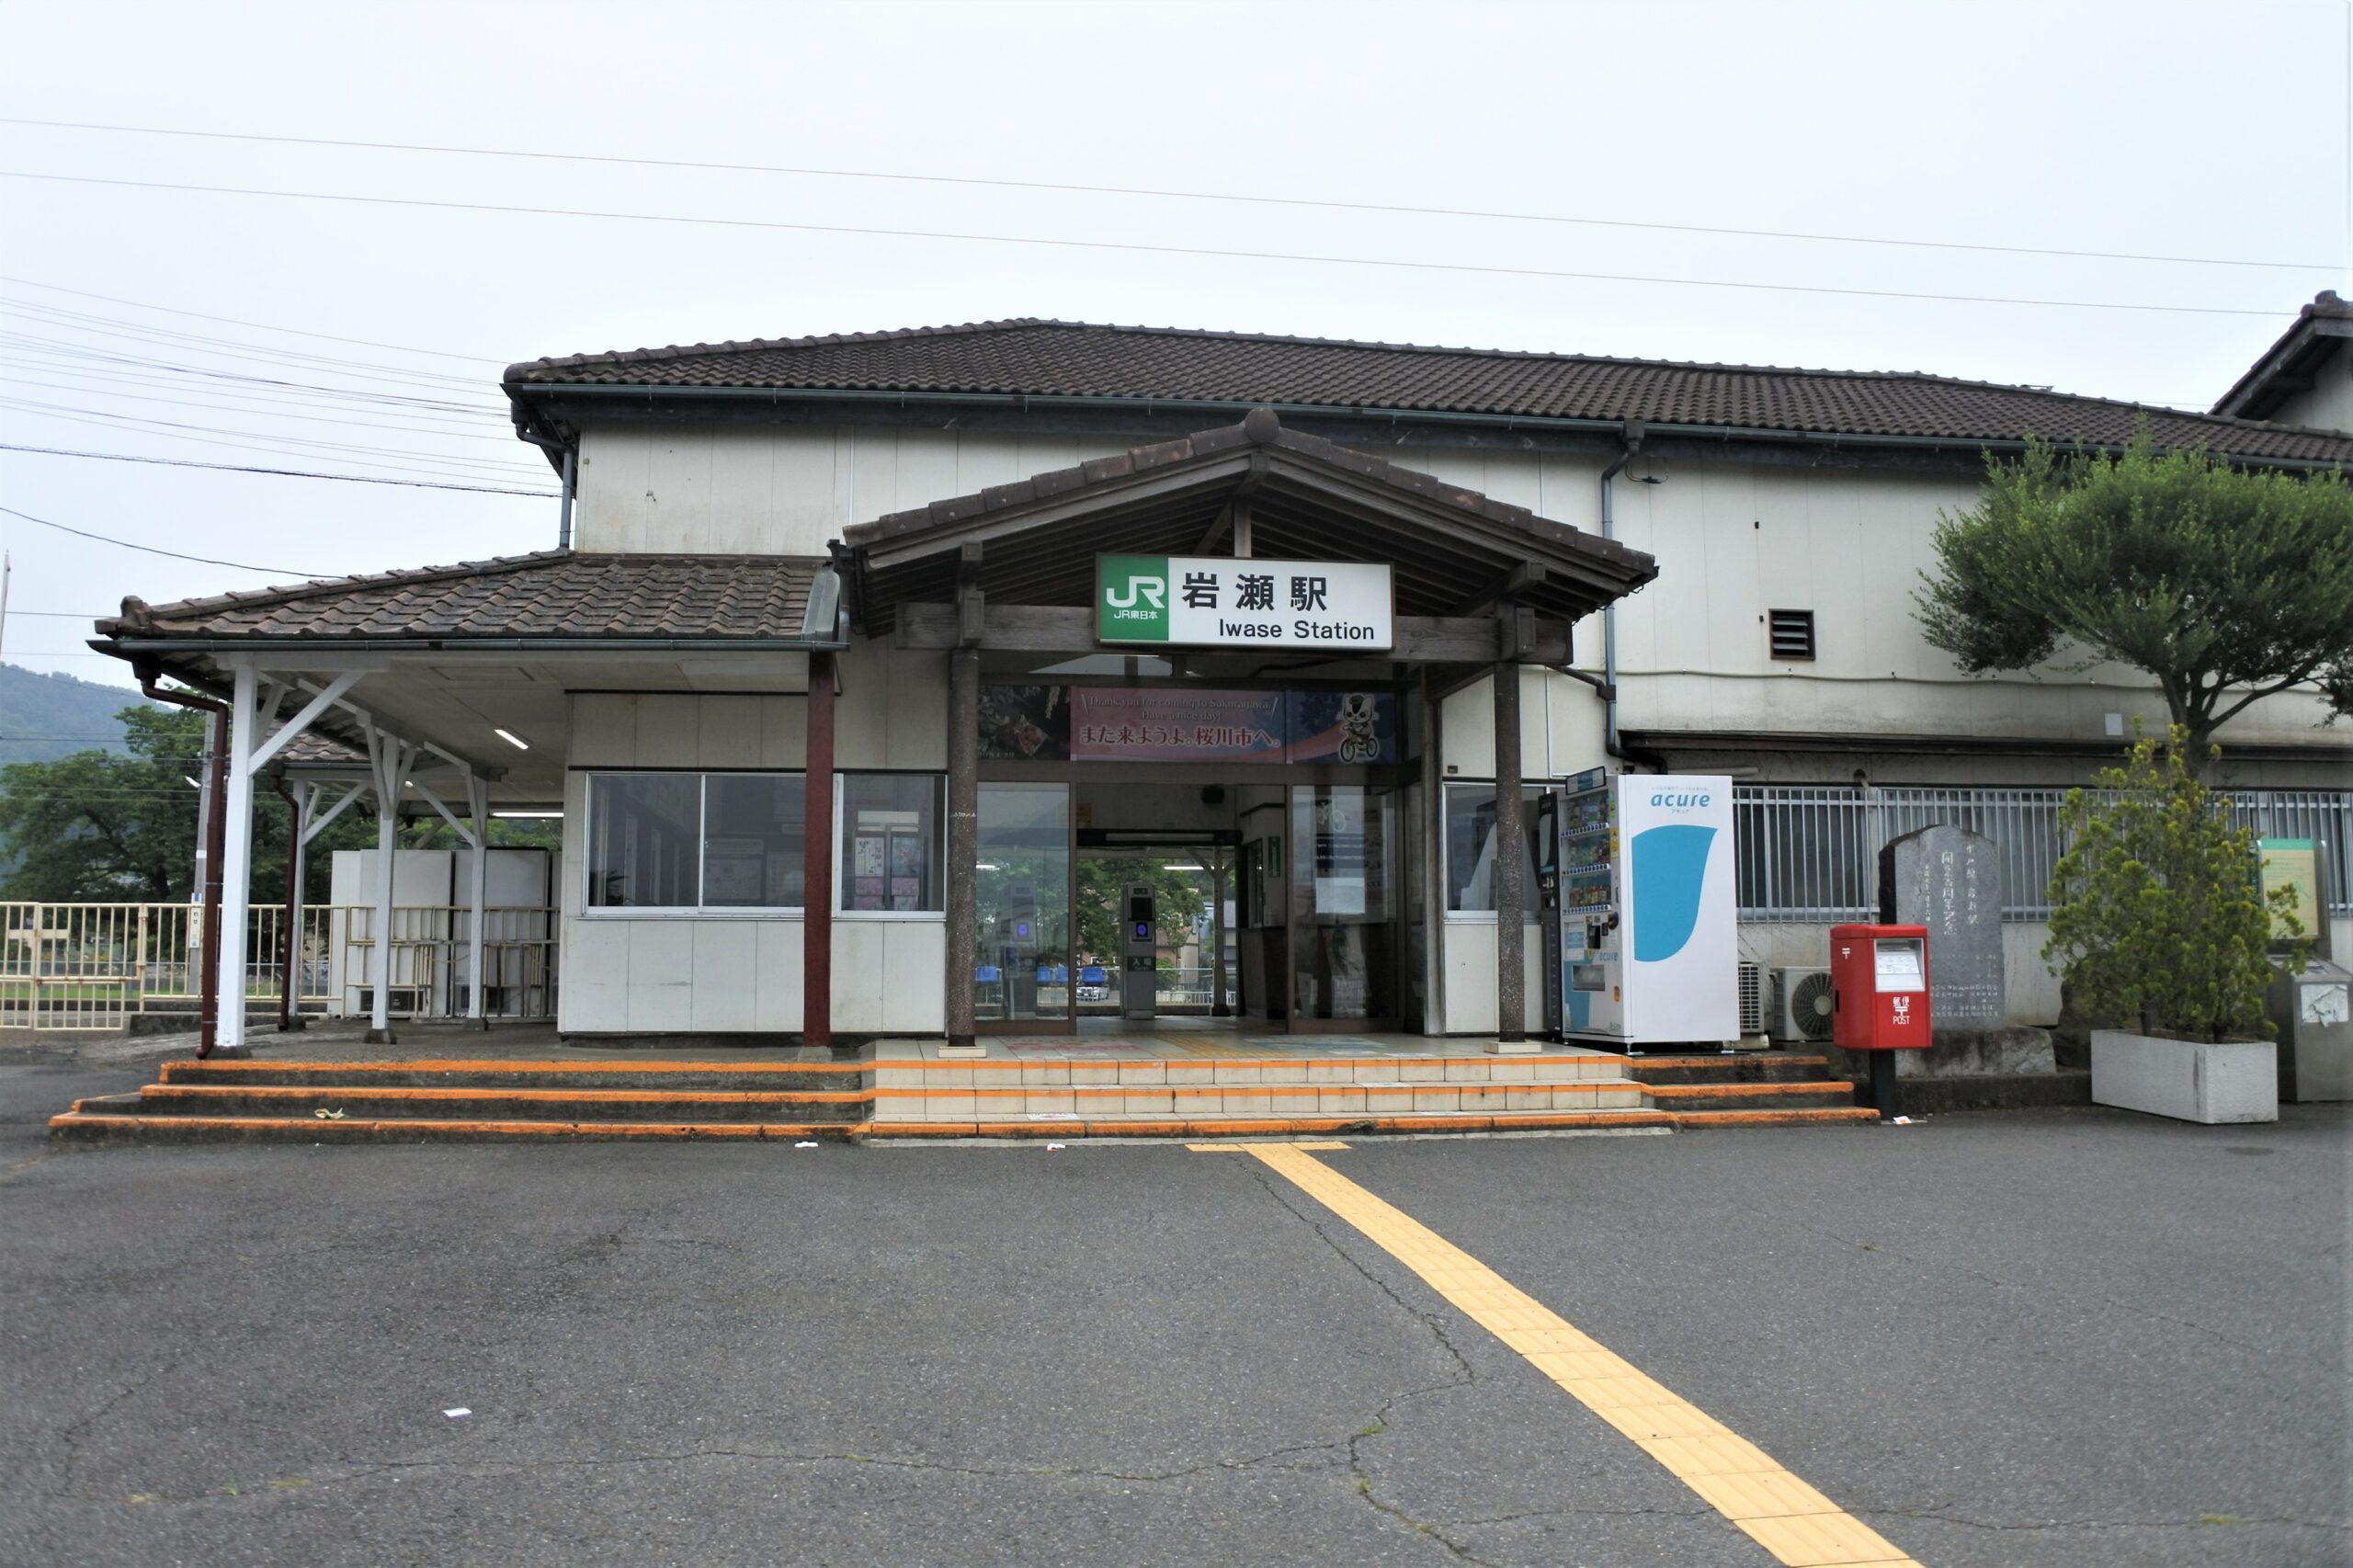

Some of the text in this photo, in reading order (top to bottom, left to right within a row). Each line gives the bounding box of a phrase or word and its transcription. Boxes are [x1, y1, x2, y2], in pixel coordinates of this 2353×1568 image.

[1106, 575, 1165, 608] JR
[1182, 572, 1327, 612] 岩瀬駅
[1113, 609, 1158, 619] JR東日本
[1220, 619, 1374, 640] Iwase Station
[1089, 696, 1272, 710] Thank you for coming to Sakuragawa.
[1141, 710, 1165, 721] Have
[1169, 712, 1176, 721] a
[1177, 711, 1199, 721] nice
[1080, 726, 1280, 746] また来ようよ。桜川市へ。
[1651, 794, 1711, 807] acure
[1893, 996, 1909, 1006] 郵便
[1893, 1016, 1910, 1025] POST
